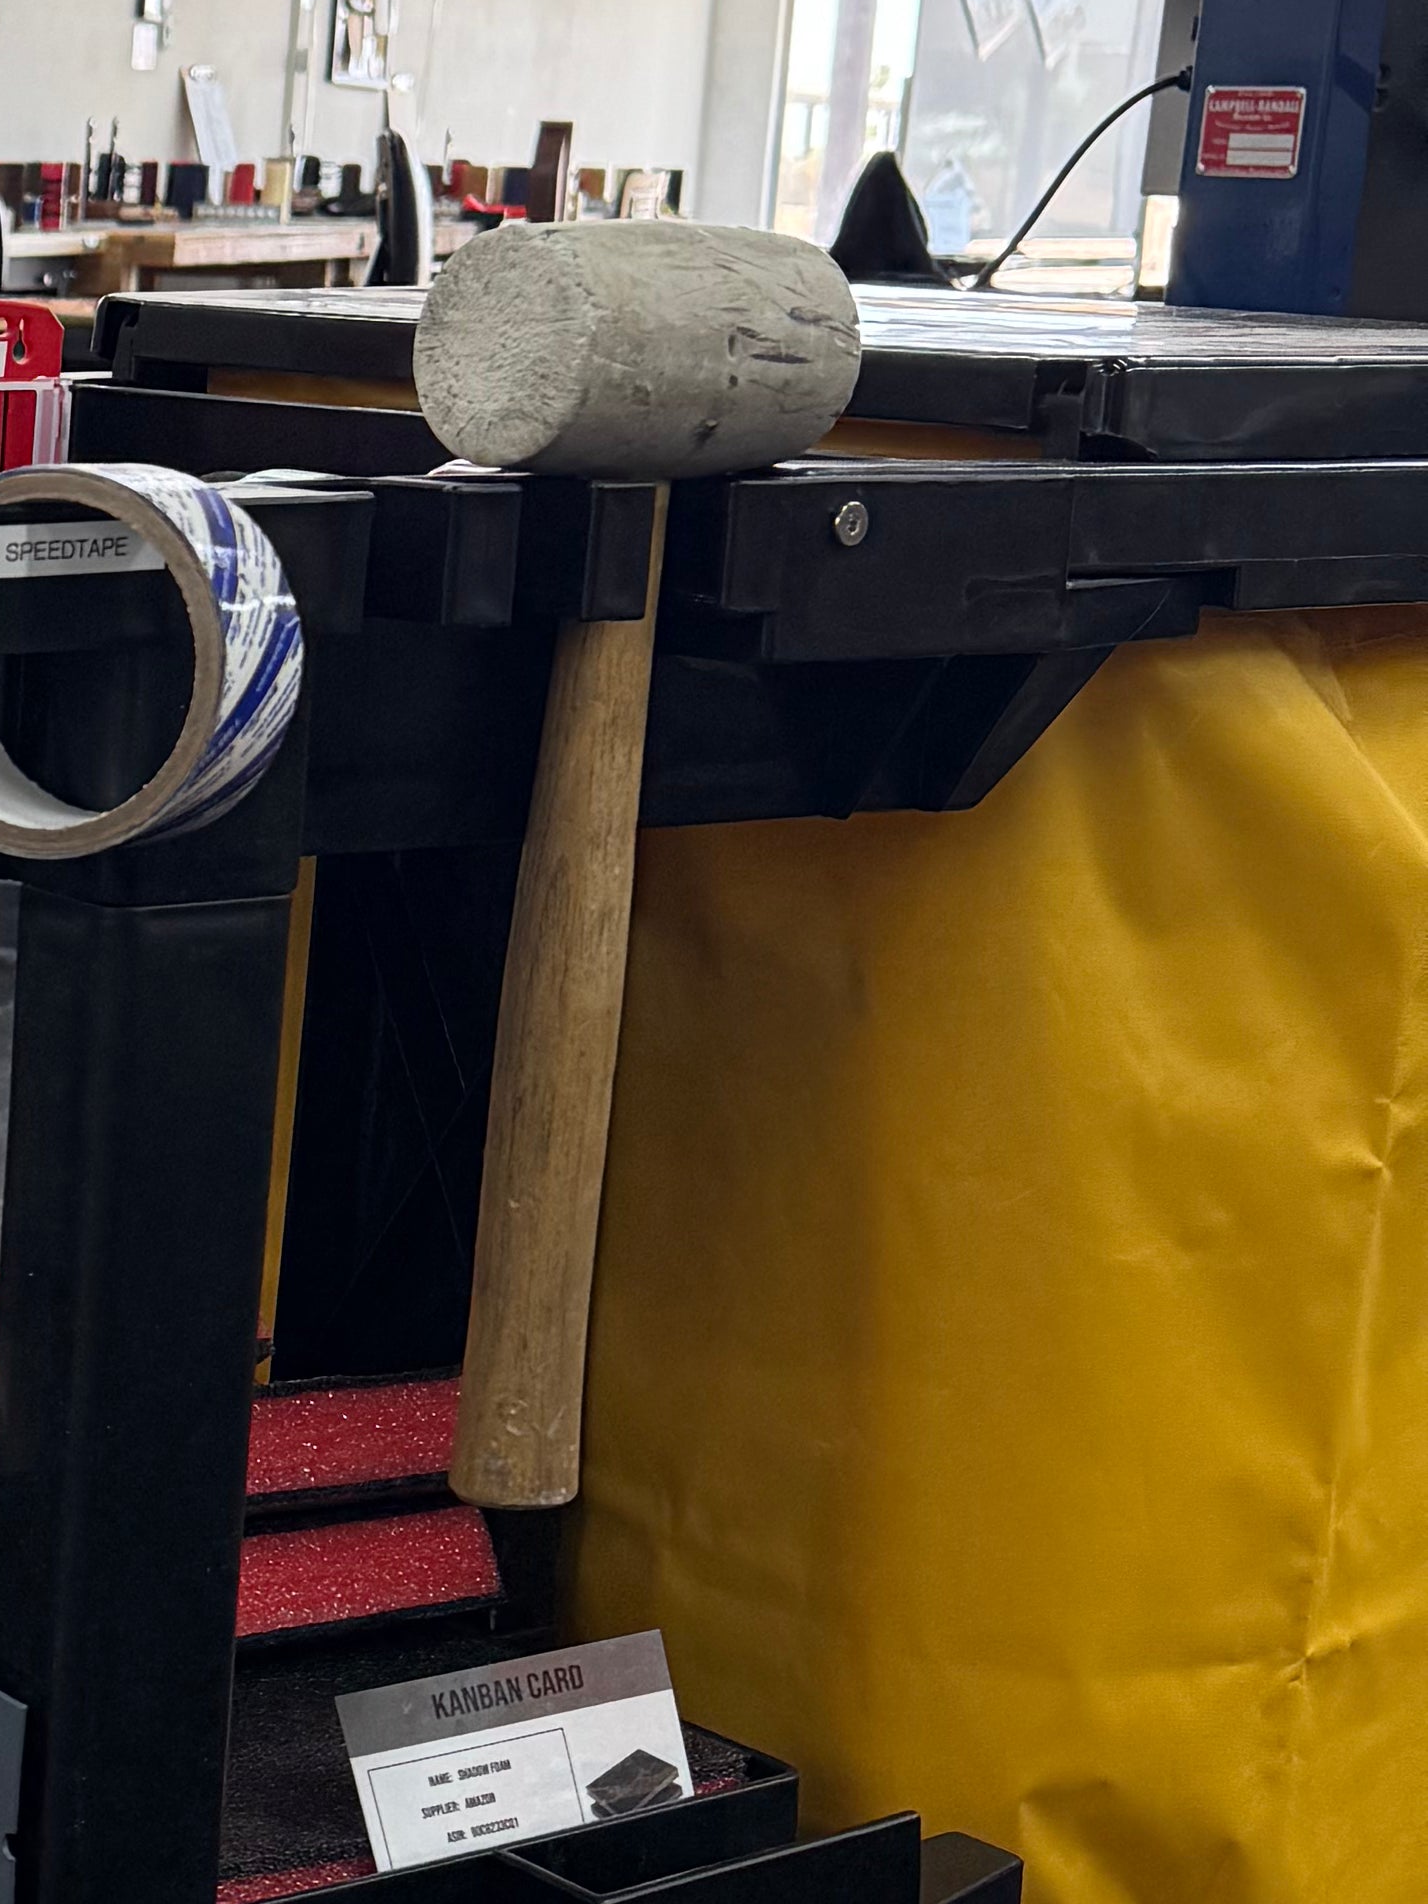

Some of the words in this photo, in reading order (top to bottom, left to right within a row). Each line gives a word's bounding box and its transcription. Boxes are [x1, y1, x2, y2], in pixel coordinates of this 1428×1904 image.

[4, 536, 129, 563] SPEEDTAPE
[431, 1675, 523, 1720] KANBAN
[526, 1664, 585, 1698] CARD
